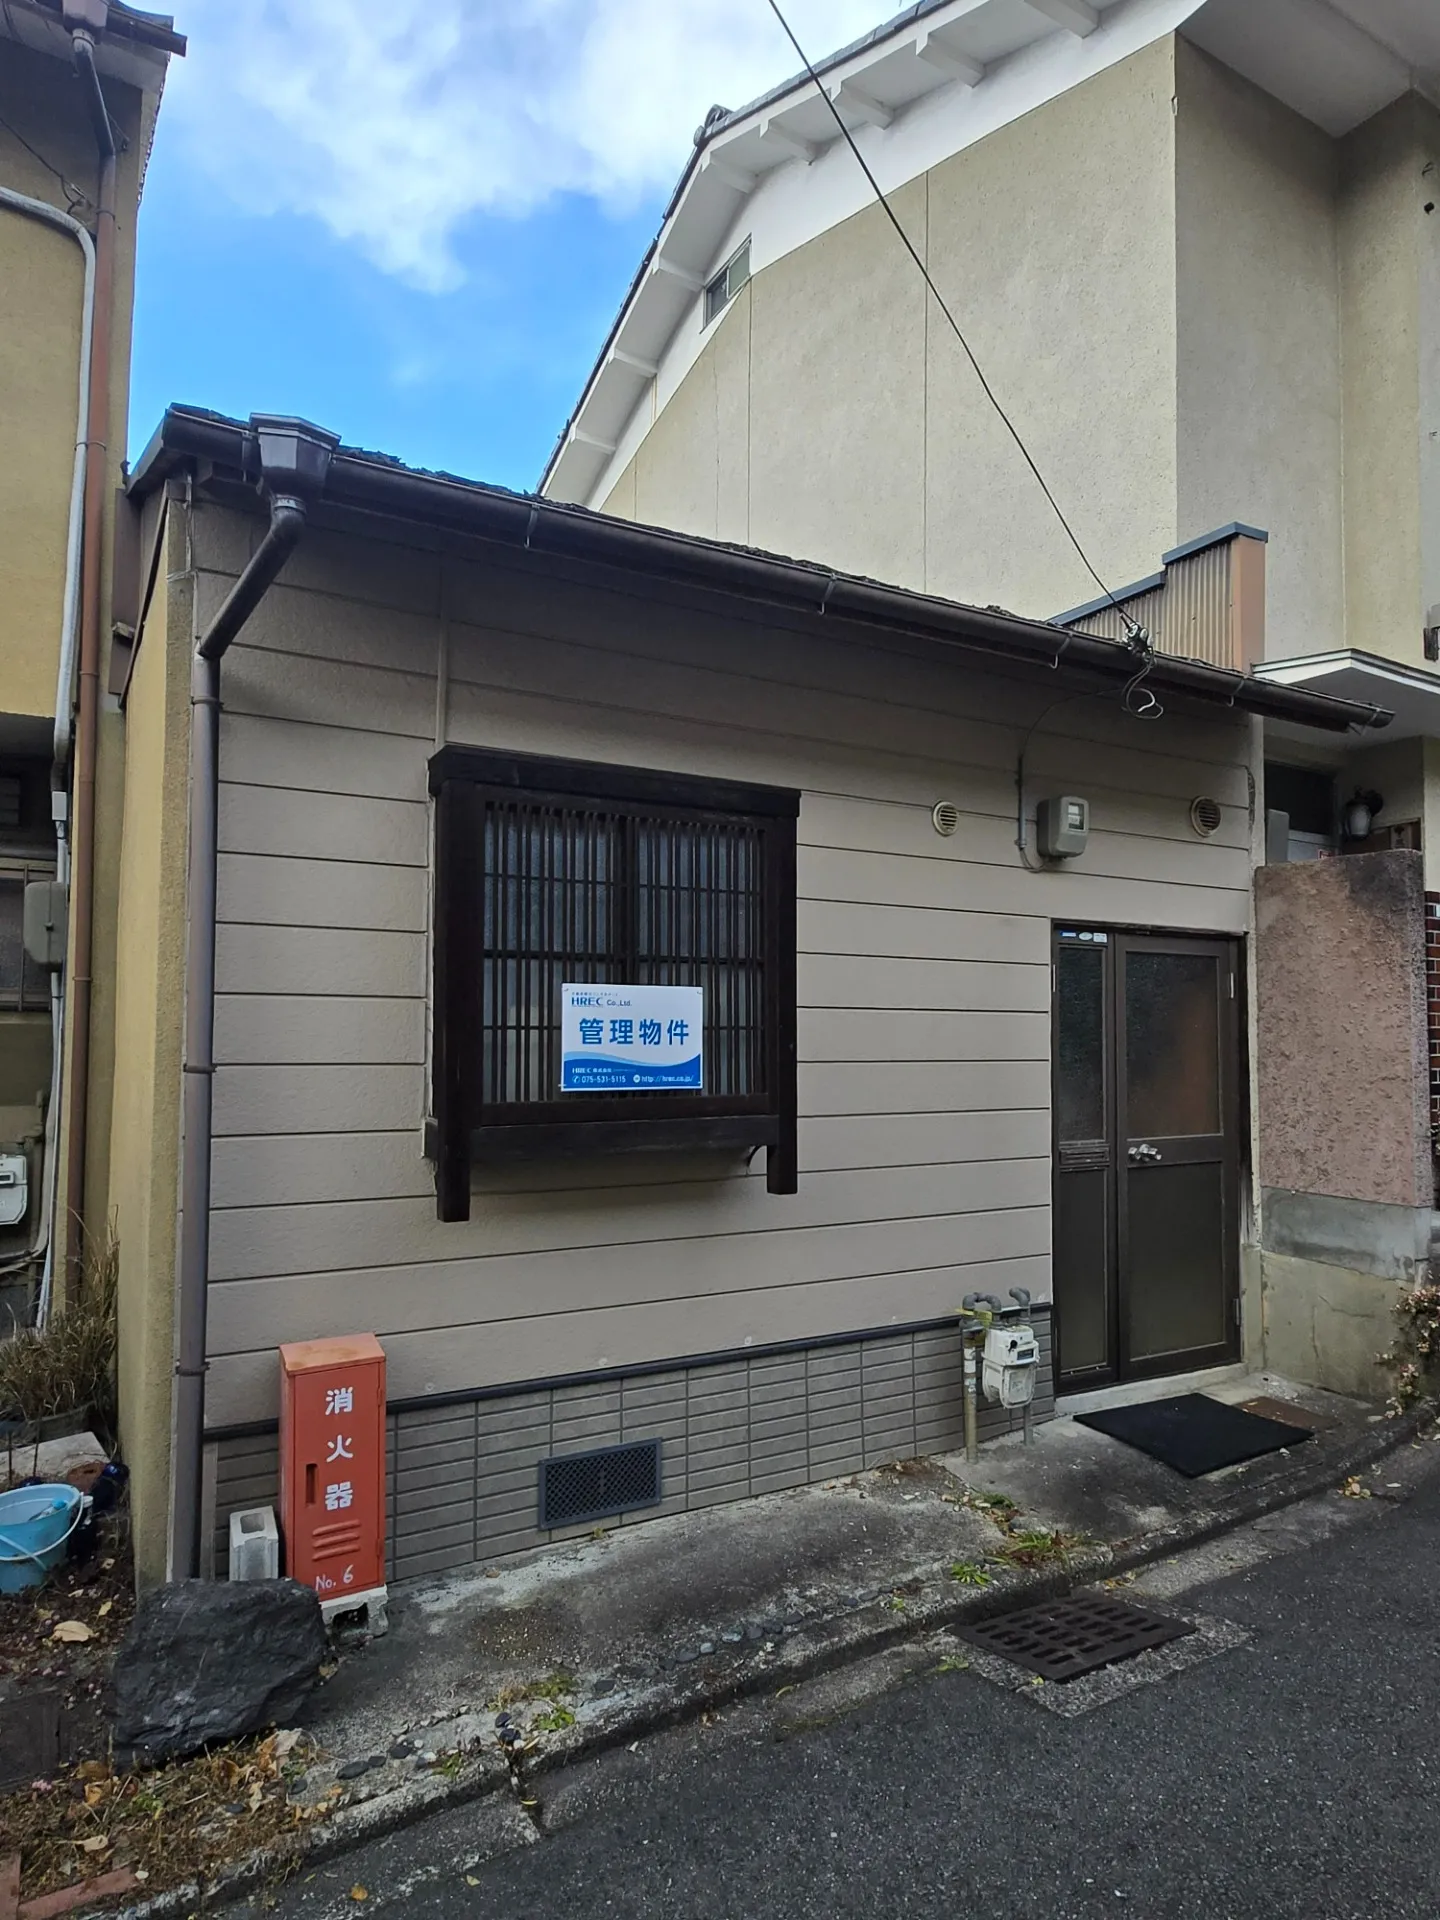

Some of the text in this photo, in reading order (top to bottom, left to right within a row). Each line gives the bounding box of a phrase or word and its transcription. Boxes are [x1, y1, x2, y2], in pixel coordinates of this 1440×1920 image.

[572, 997, 603, 1006] HREC
[579, 1017, 689, 1046] 管理物件
[325, 1386, 353, 1511] 消火器
[315, 1564, 354, 1592] No. 6
